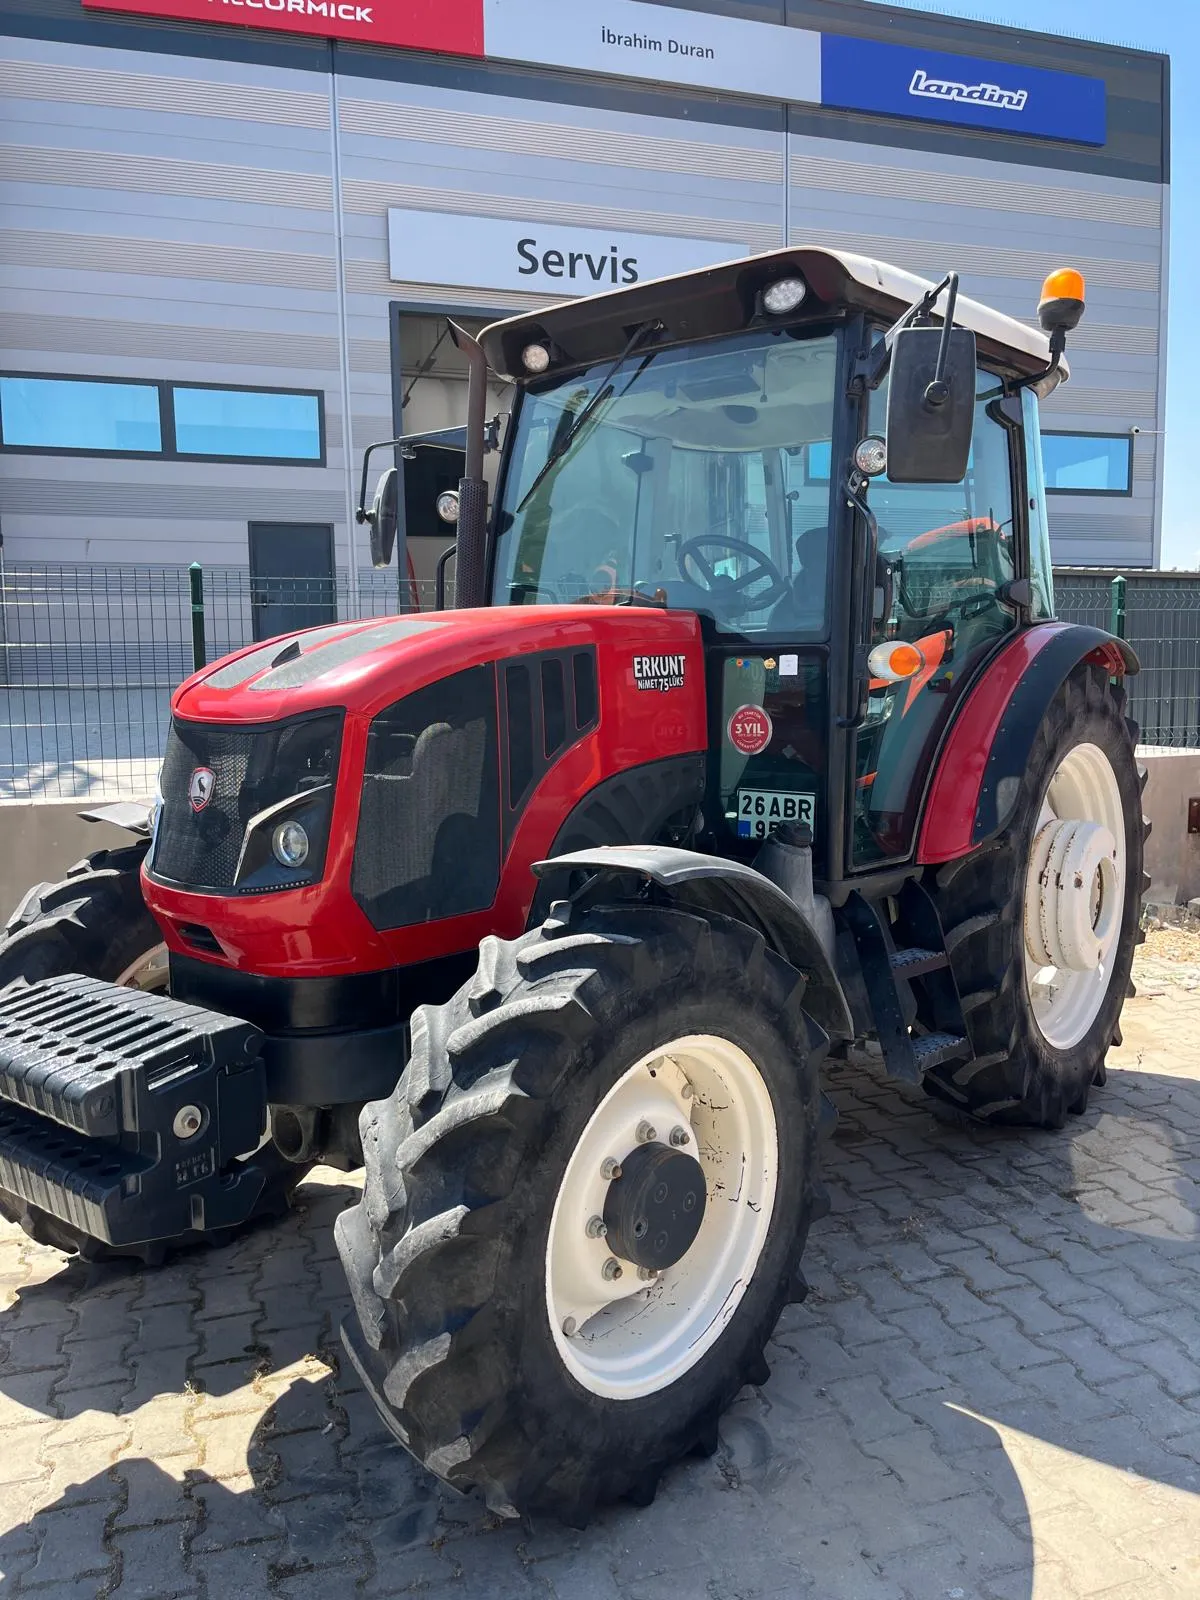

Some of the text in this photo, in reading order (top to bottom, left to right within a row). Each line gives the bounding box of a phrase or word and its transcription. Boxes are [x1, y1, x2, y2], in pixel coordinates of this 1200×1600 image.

[207, 0, 374, 23] CORMICK
[601, 25, 715, 59] İbrahim Duran
[908, 69, 1028, 111] Landini
[517, 238, 639, 284] Servis
[633, 655, 686, 678] ERKUNT
[658, 678, 670, 692] 75
[735, 723, 765, 735] 3 YIL
[742, 795, 812, 819] 26 ABR
